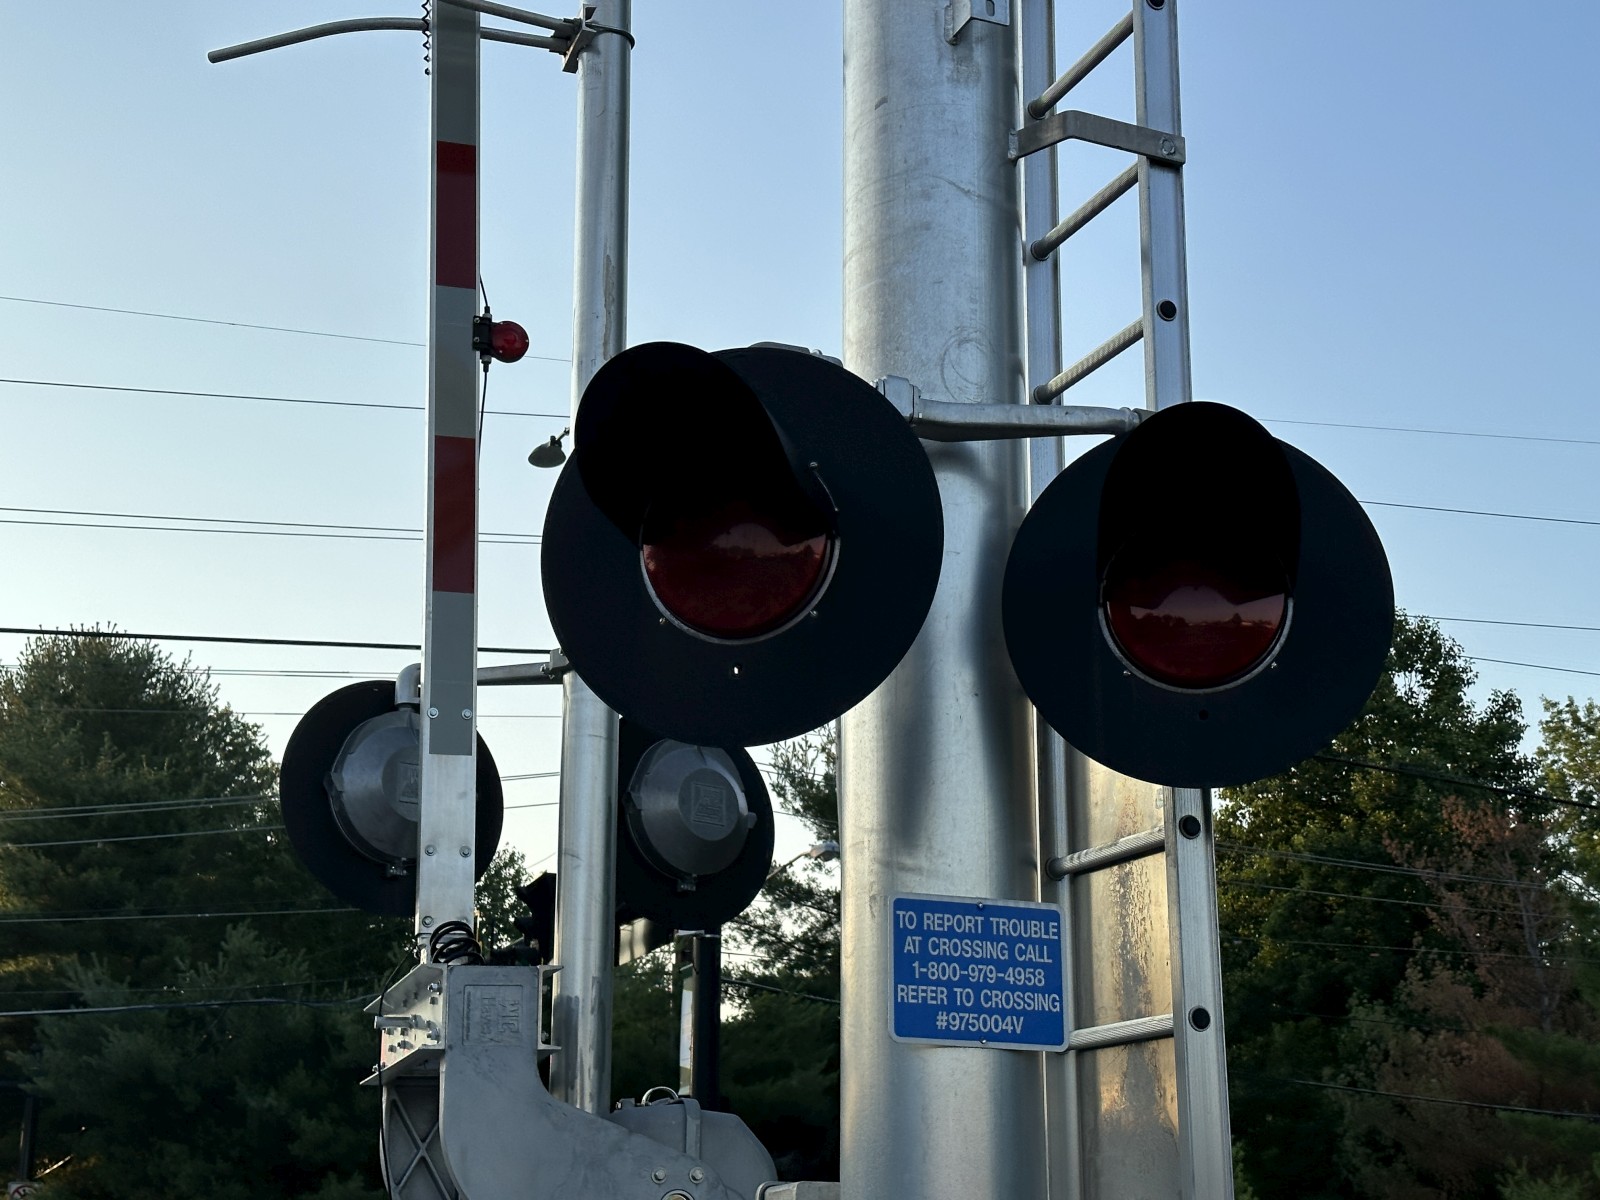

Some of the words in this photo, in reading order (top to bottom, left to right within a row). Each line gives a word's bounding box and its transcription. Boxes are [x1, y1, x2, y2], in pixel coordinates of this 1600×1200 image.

[896, 910, 917, 929] TO
[924, 912, 984, 934] REPORT
[990, 917, 1059, 940] TROUBLE
[904, 936, 922, 954] AT
[928, 937, 1009, 960] CROSSING
[1015, 944, 1053, 963] CALL
[912, 961, 1045, 987] 1-800-979-4958
[897, 984, 948, 1005] REFER
[953, 988, 974, 1007] TO
[980, 990, 1060, 1012] CROSSING
[936, 1011, 1024, 1034] #975004V
